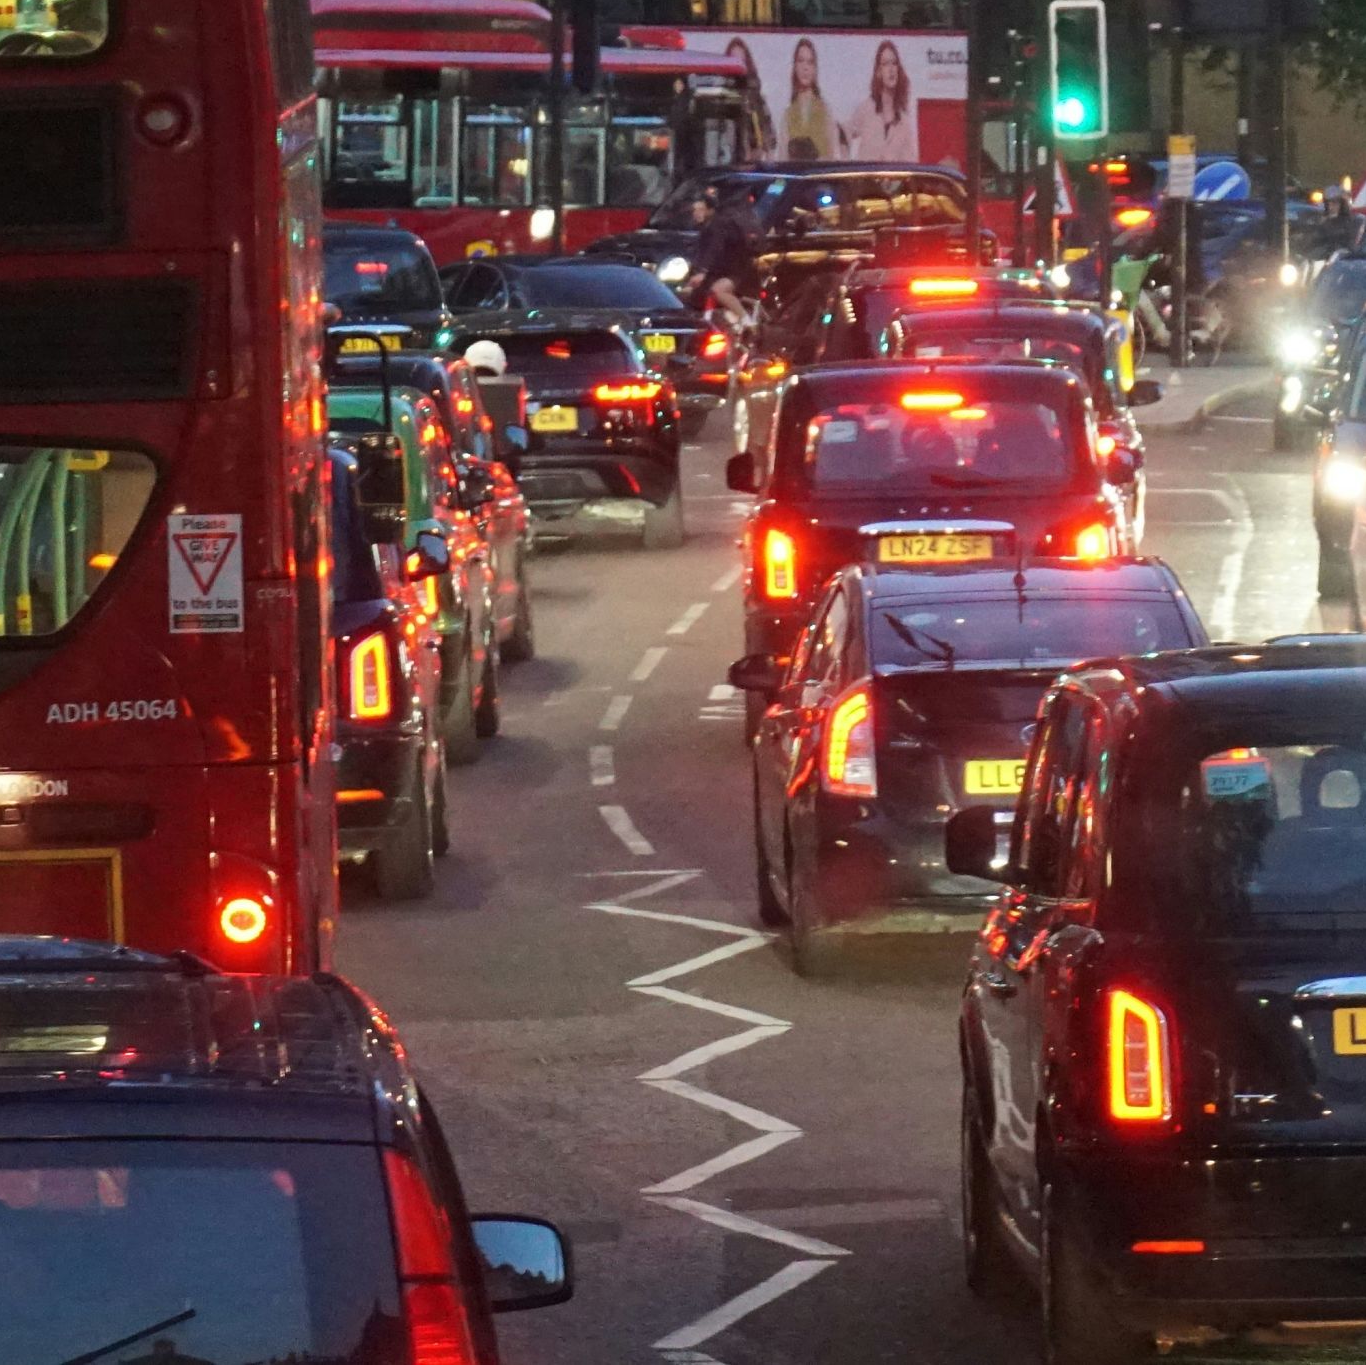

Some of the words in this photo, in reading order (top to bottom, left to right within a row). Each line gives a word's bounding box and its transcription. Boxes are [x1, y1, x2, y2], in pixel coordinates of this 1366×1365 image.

[182, 518, 226, 529] Please
[889, 538, 938, 556] LN24
[46, 702, 100, 724] ADH
[104, 699, 178, 721] 45064
